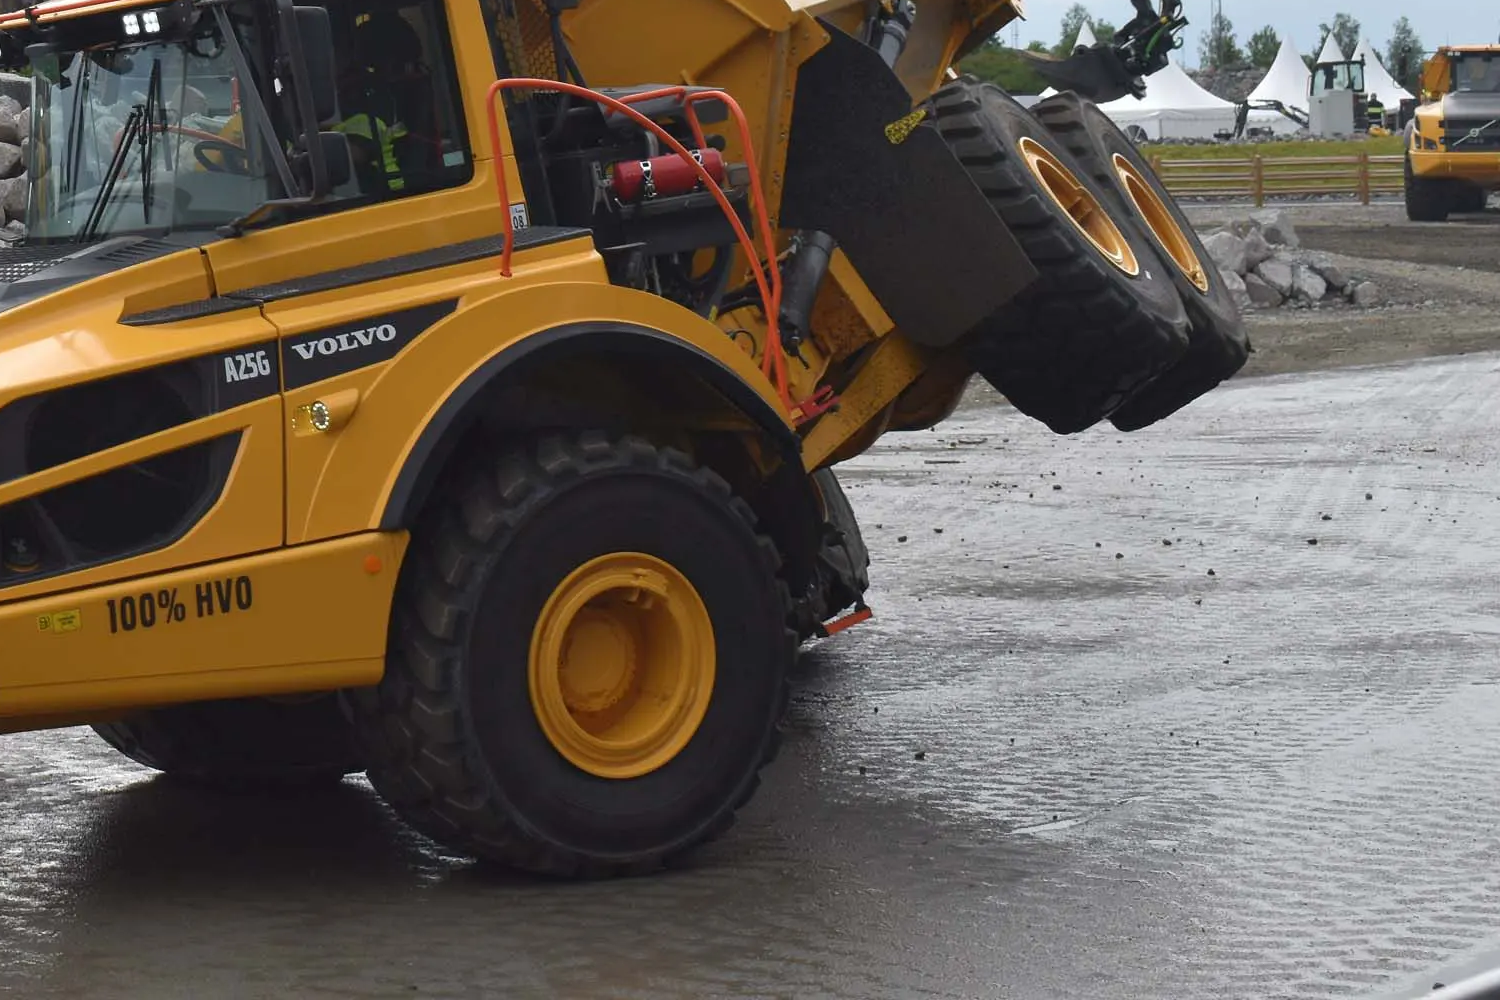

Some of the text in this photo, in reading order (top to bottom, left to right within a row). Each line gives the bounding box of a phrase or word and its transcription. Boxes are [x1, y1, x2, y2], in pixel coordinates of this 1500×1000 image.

[292, 324, 397, 360] VOLVO
[224, 350, 271, 383] A25G
[107, 575, 253, 634] 100% HVO
